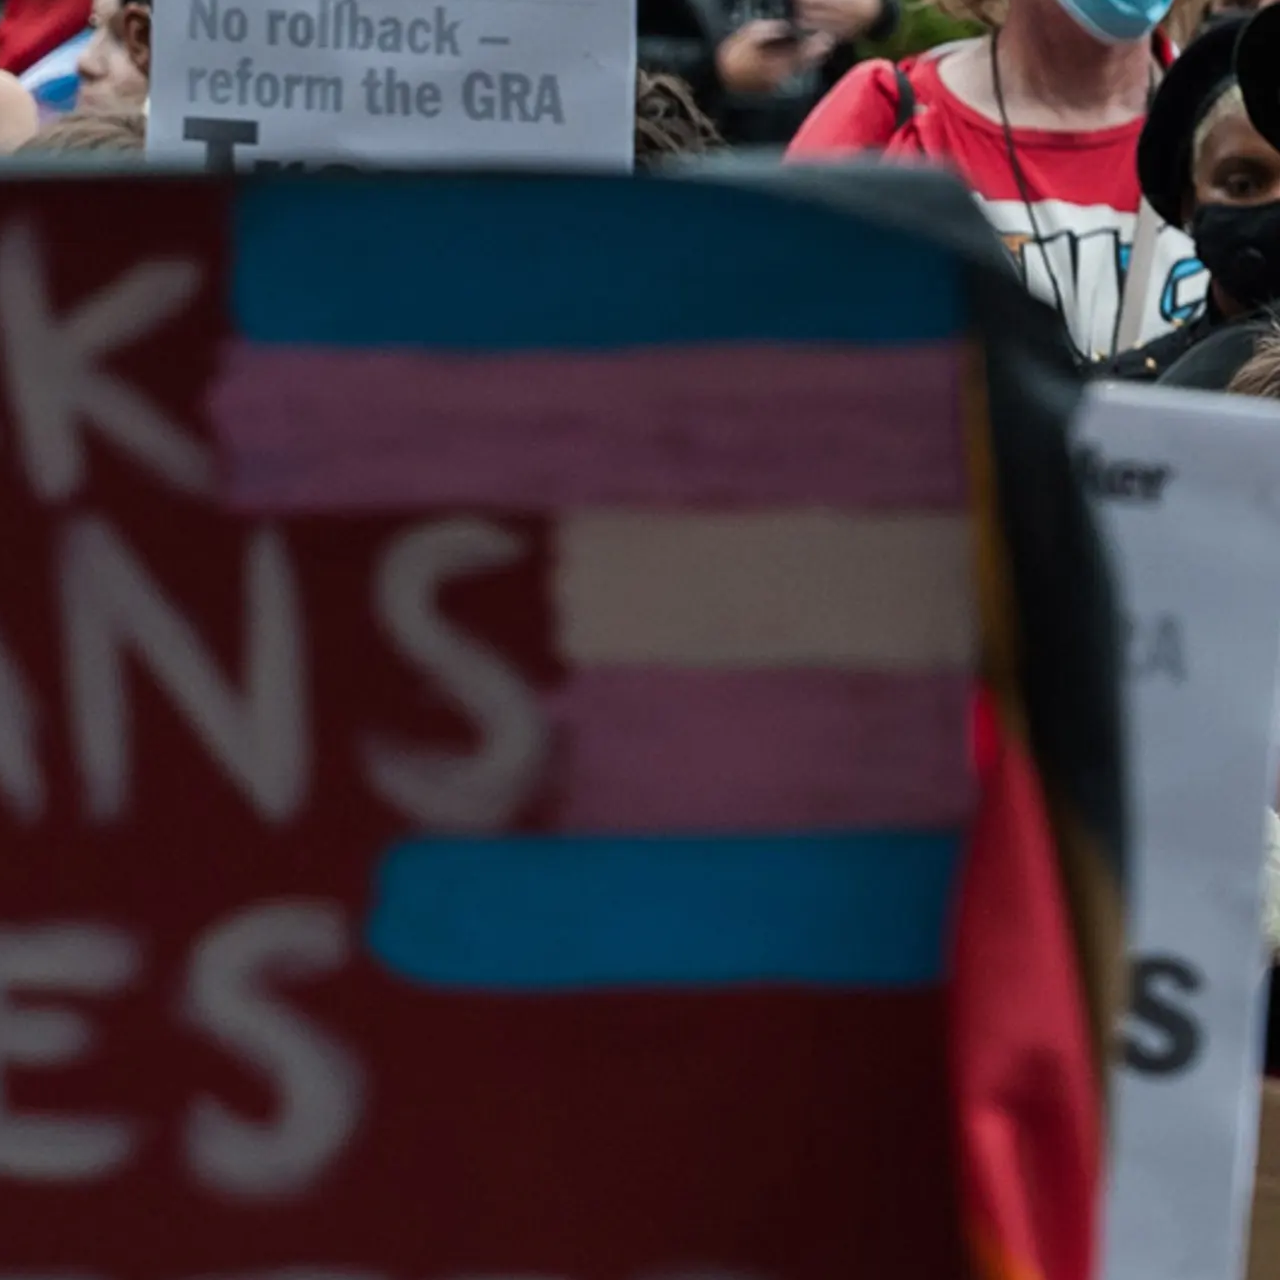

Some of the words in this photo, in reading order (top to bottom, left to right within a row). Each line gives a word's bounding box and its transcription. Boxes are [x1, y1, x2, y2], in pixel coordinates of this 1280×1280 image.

[186, 58, 344, 113] reform
[362, 67, 442, 119] the
[461, 71, 564, 124] GRA
